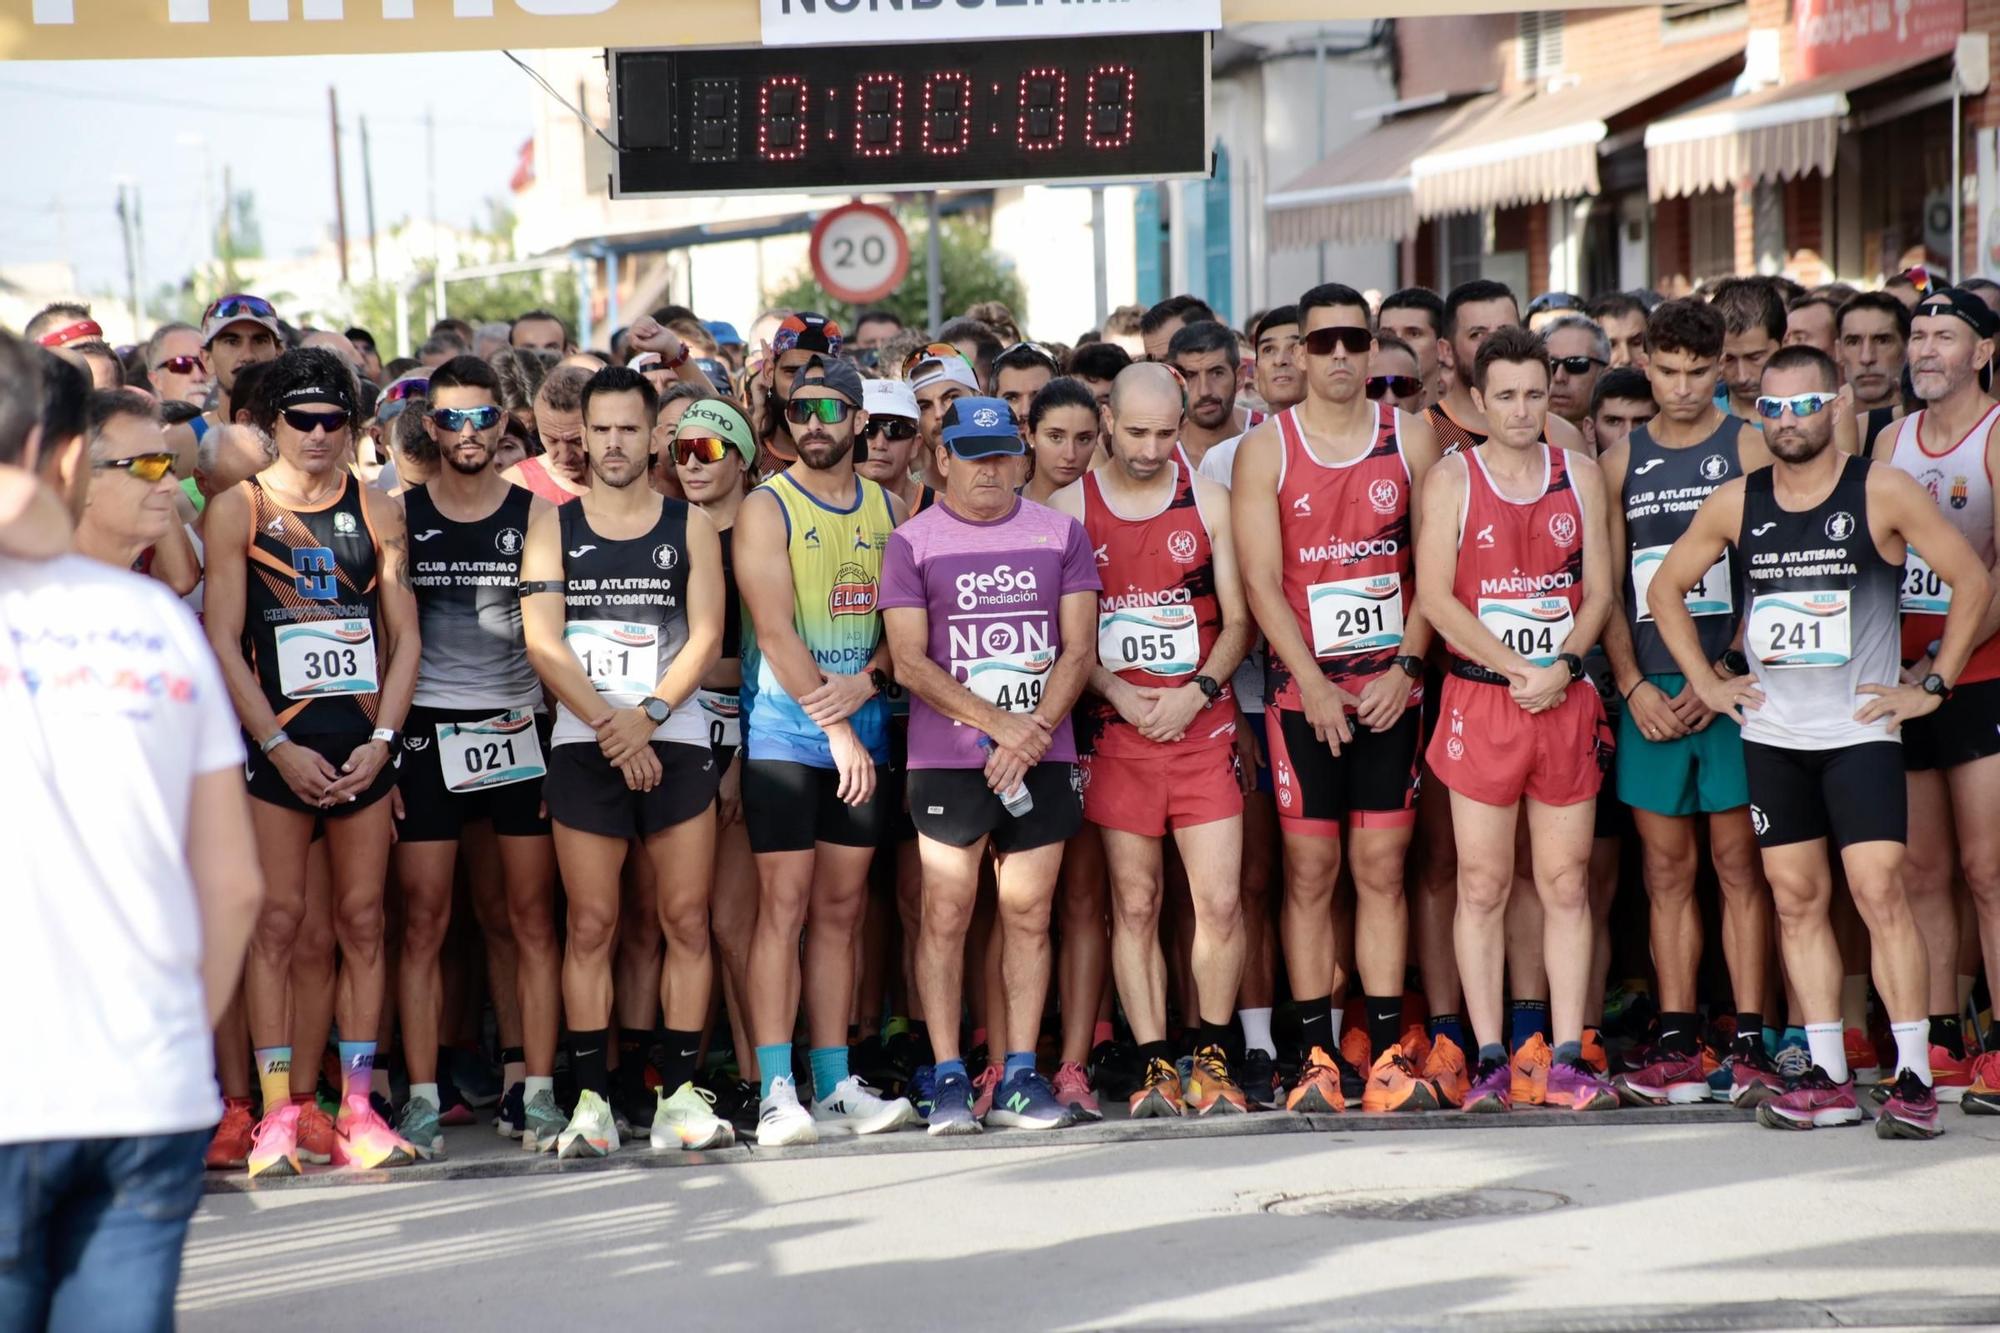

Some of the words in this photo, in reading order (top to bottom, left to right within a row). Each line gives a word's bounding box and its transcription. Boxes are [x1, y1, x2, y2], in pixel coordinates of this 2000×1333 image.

[760, 64, 1133, 160] 0:00:00
[832, 236, 885, 267] 20
[1629, 492, 1655, 506] CLUB
[417, 561, 446, 572] CLUB
[450, 562, 517, 572] ATLETISMO
[1752, 552, 1779, 565] CLUB
[1782, 548, 1847, 563] ATLETISMO
[1786, 563, 1857, 578] TORREVIEJA
[568, 579, 597, 591] CLUB
[600, 578, 671, 590] ATLETISMO
[979, 590, 1038, 605] mediación
[605, 594, 676, 607] TORREVIEJA
[1336, 604, 1384, 637] 291
[991, 634, 1009, 646] 27
[1122, 633, 1176, 663] 055
[1501, 626, 1554, 655] 404
[1770, 621, 1821, 650] 241
[304, 648, 358, 680] 303
[997, 679, 1041, 711] 449
[464, 738, 516, 774] 021
